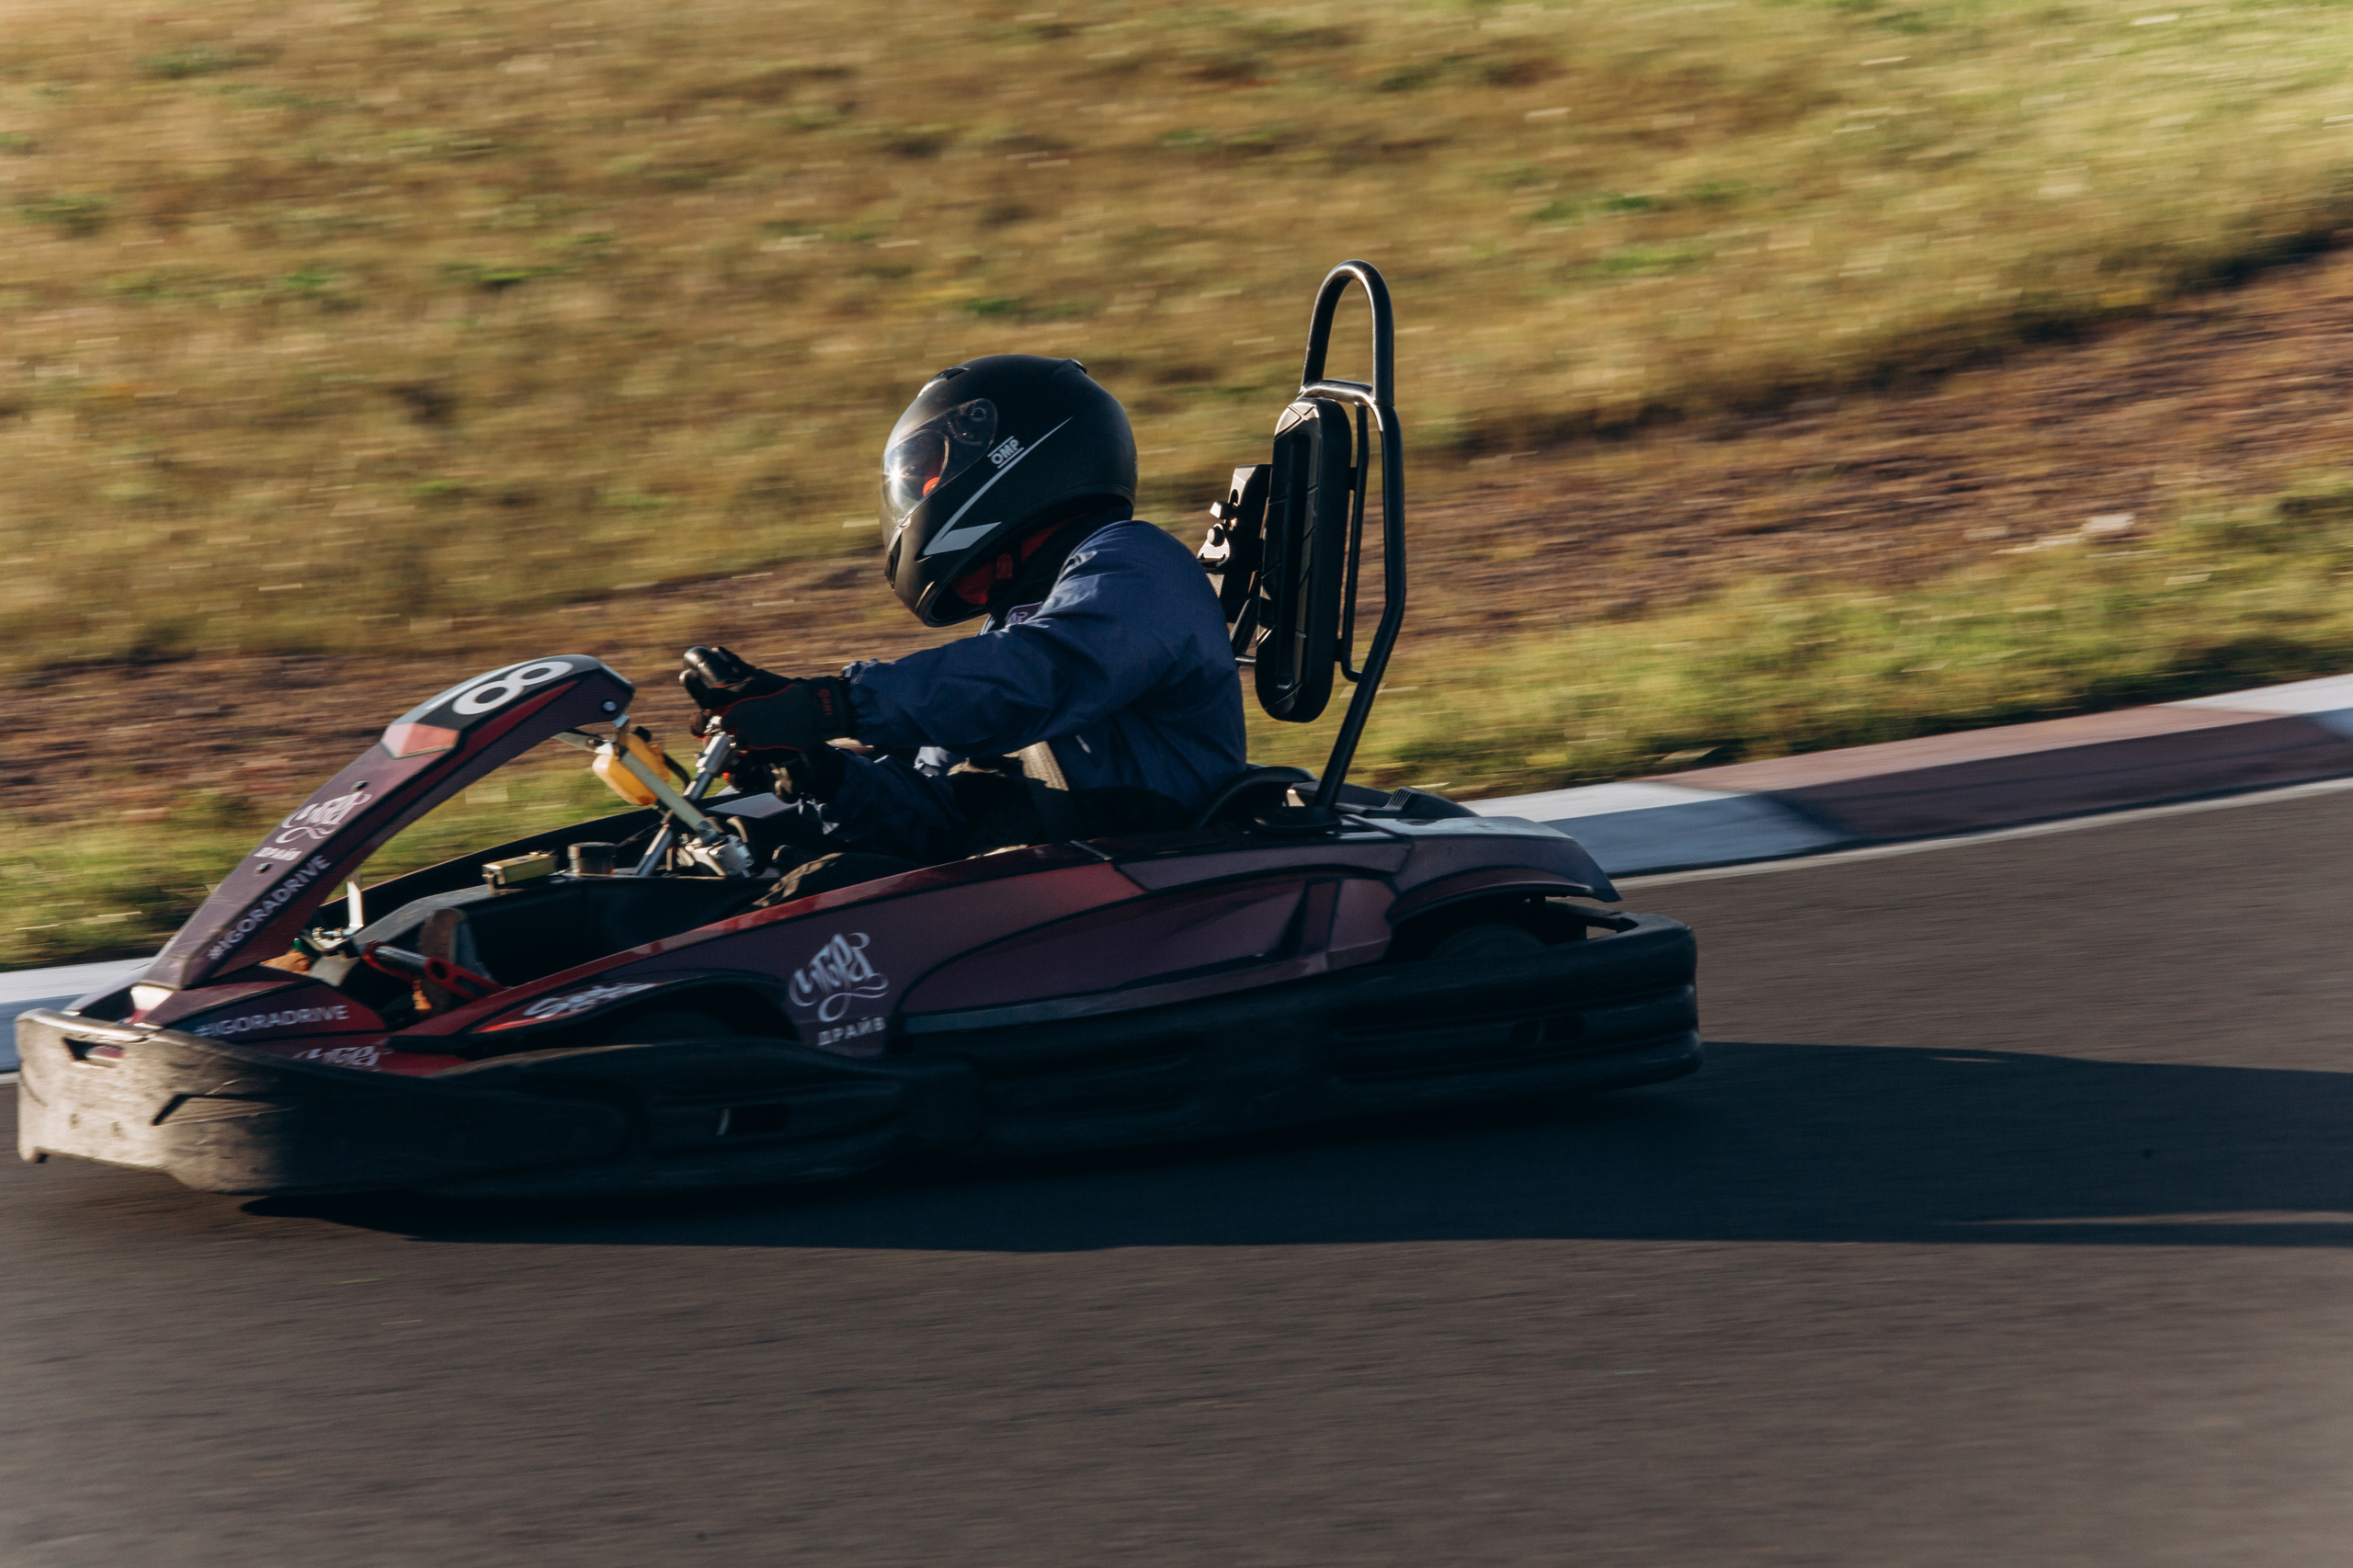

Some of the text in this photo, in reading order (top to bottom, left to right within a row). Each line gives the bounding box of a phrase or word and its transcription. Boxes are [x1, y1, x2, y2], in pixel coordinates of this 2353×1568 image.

[991, 438, 1019, 465] OMP
[207, 855, 332, 960] #IGORADRIVE
[194, 1005, 350, 1038] #IGORADRIVE
